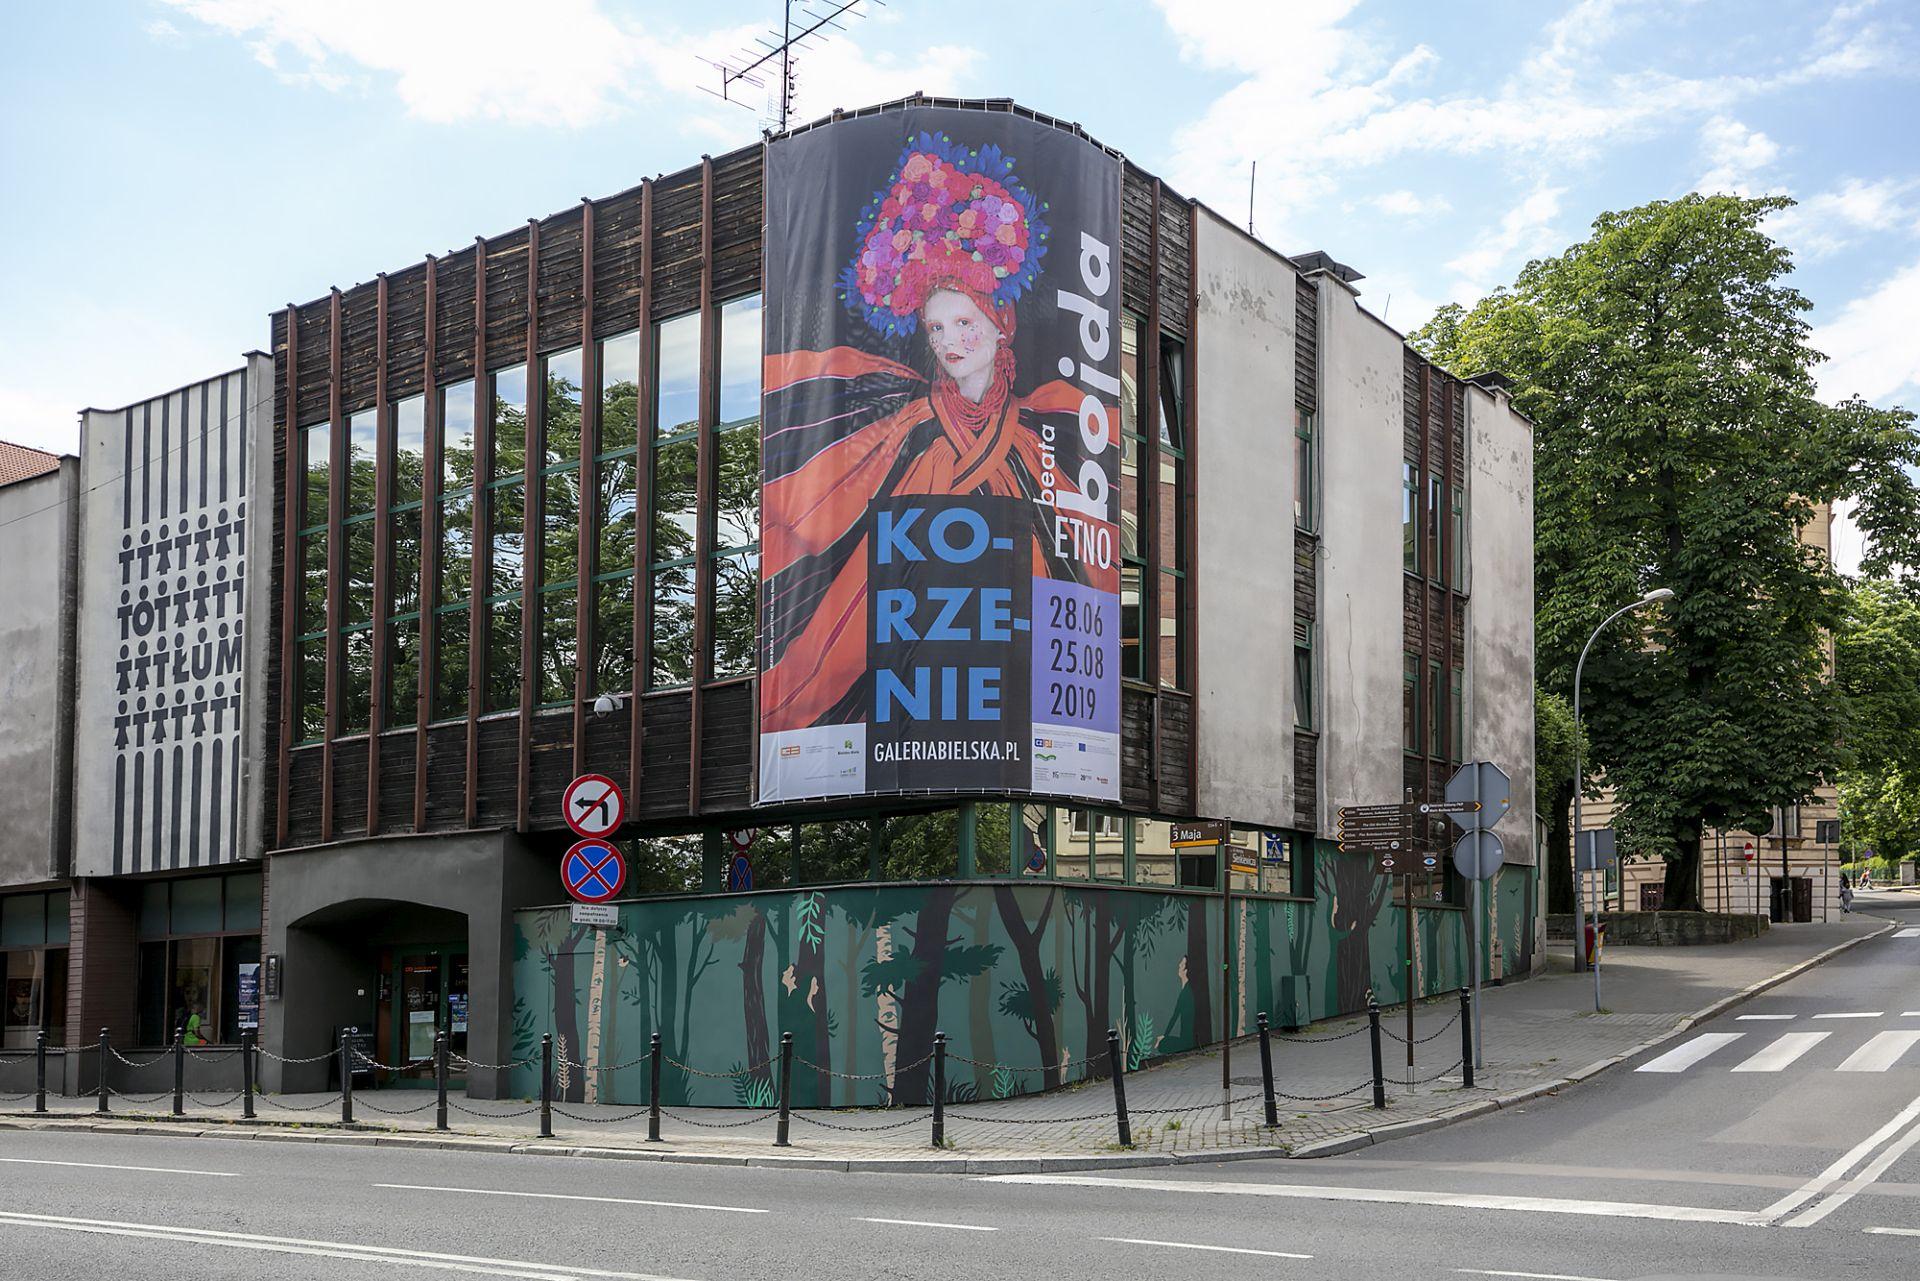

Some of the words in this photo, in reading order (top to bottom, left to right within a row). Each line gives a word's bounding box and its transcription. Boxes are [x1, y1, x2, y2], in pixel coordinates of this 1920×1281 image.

[1032, 423, 1057, 507] beata
[876, 507, 1014, 565] KO-
[1054, 515, 1112, 570] ETNO
[876, 587, 1031, 644] RZE-
[1049, 594, 1104, 638] 28.06
[1049, 637, 1105, 680] 25.08
[875, 666, 1002, 723] NIE
[1050, 681, 1097, 721] 2019
[874, 739, 1020, 763] GALERIABIELSKA.PL
[1172, 831, 1179, 841] 3
[1180, 828, 1202, 842] Maja
